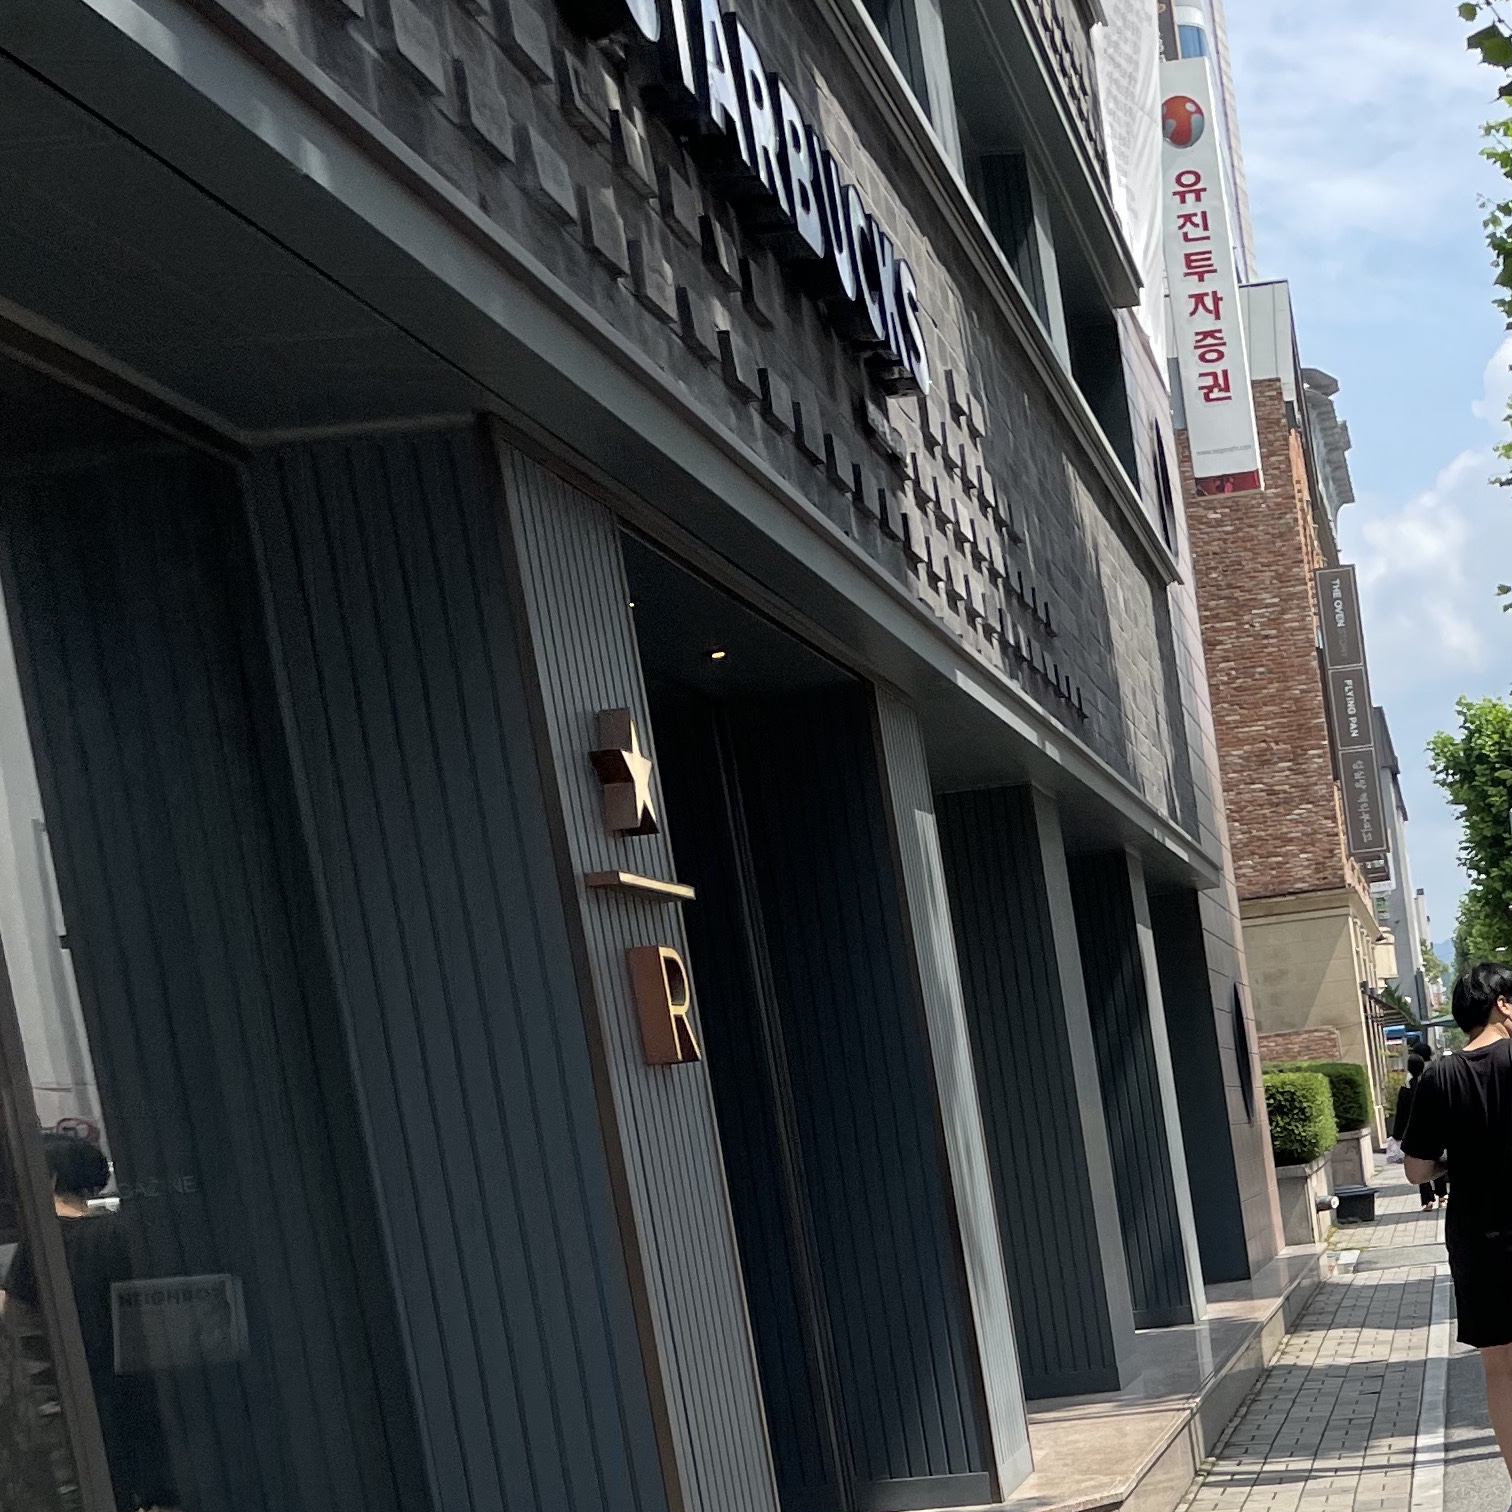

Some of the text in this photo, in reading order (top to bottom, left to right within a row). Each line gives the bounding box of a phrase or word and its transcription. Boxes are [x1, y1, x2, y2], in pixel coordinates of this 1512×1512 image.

[1172, 169, 1233, 403] 유진투자증권
[1330, 578, 1342, 598] THE
[1333, 599, 1346, 627] OVEN
[1343, 678, 1359, 738] FLYING PAN
